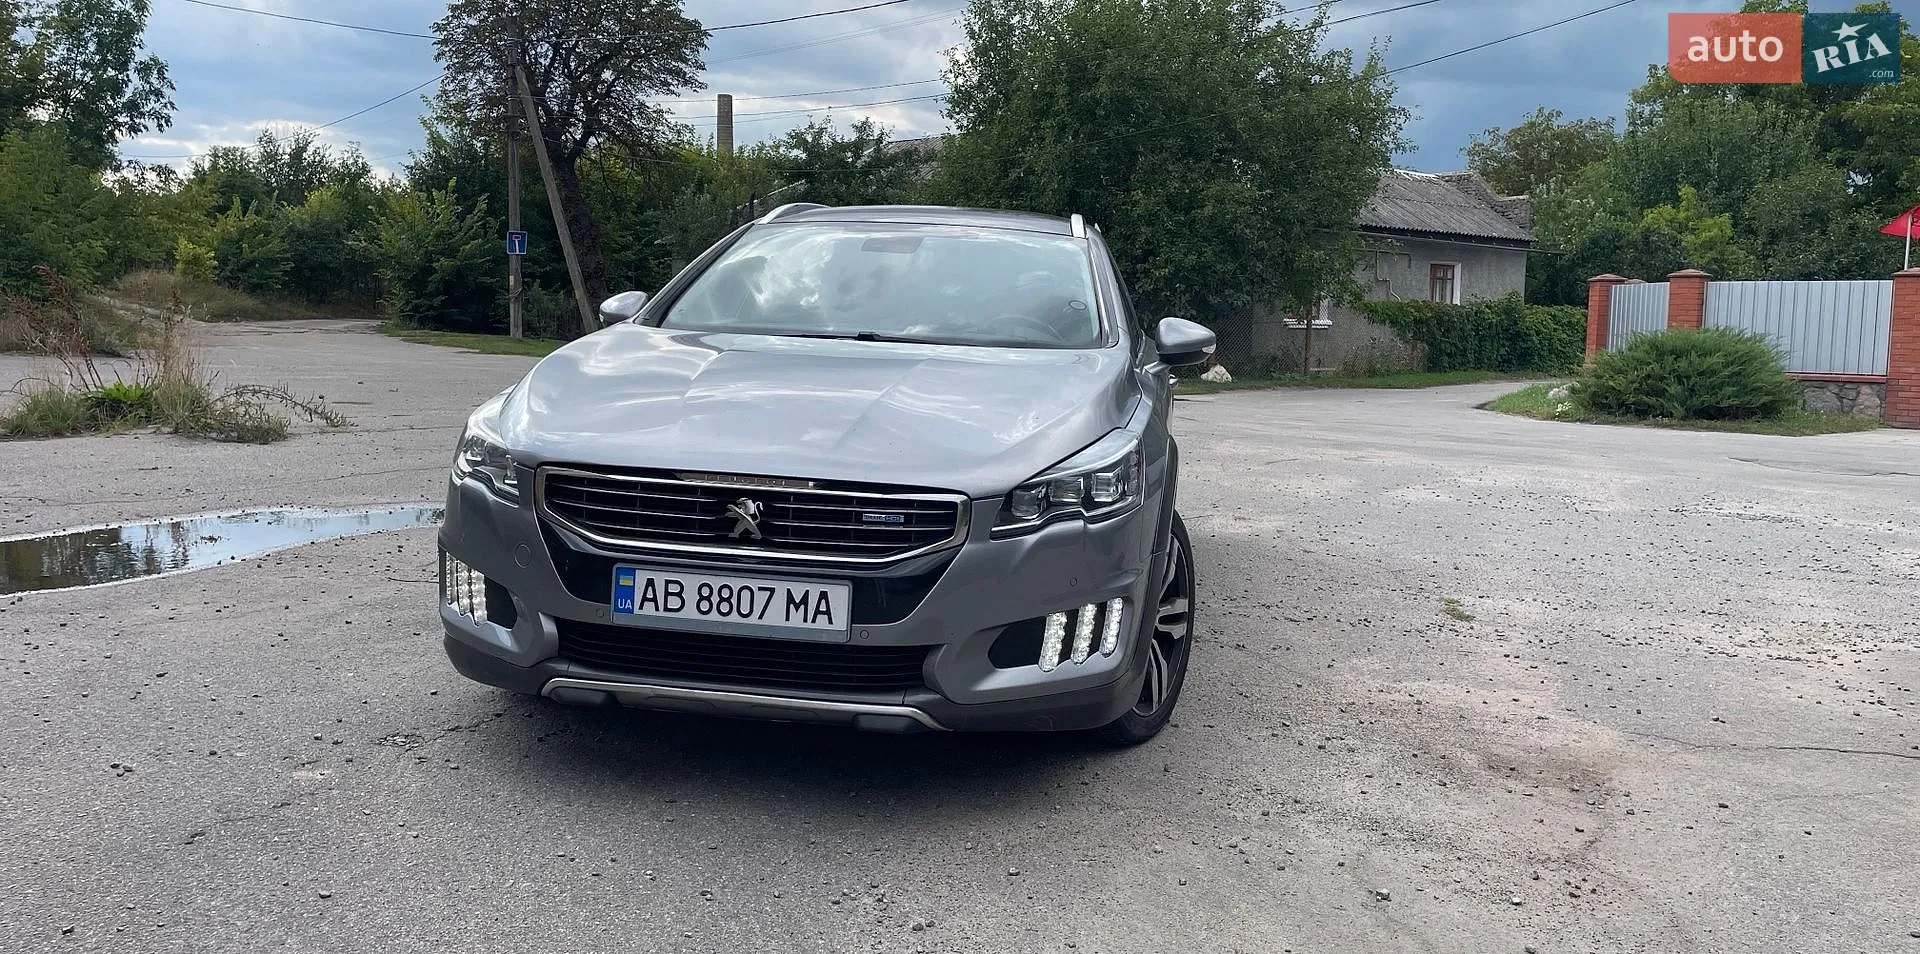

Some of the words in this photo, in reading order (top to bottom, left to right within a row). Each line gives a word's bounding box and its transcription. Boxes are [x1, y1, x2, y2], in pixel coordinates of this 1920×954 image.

[617, 597, 633, 610] UA
[638, 577, 686, 613] AB
[695, 582, 776, 621] 8807
[785, 587, 834, 625] MA
